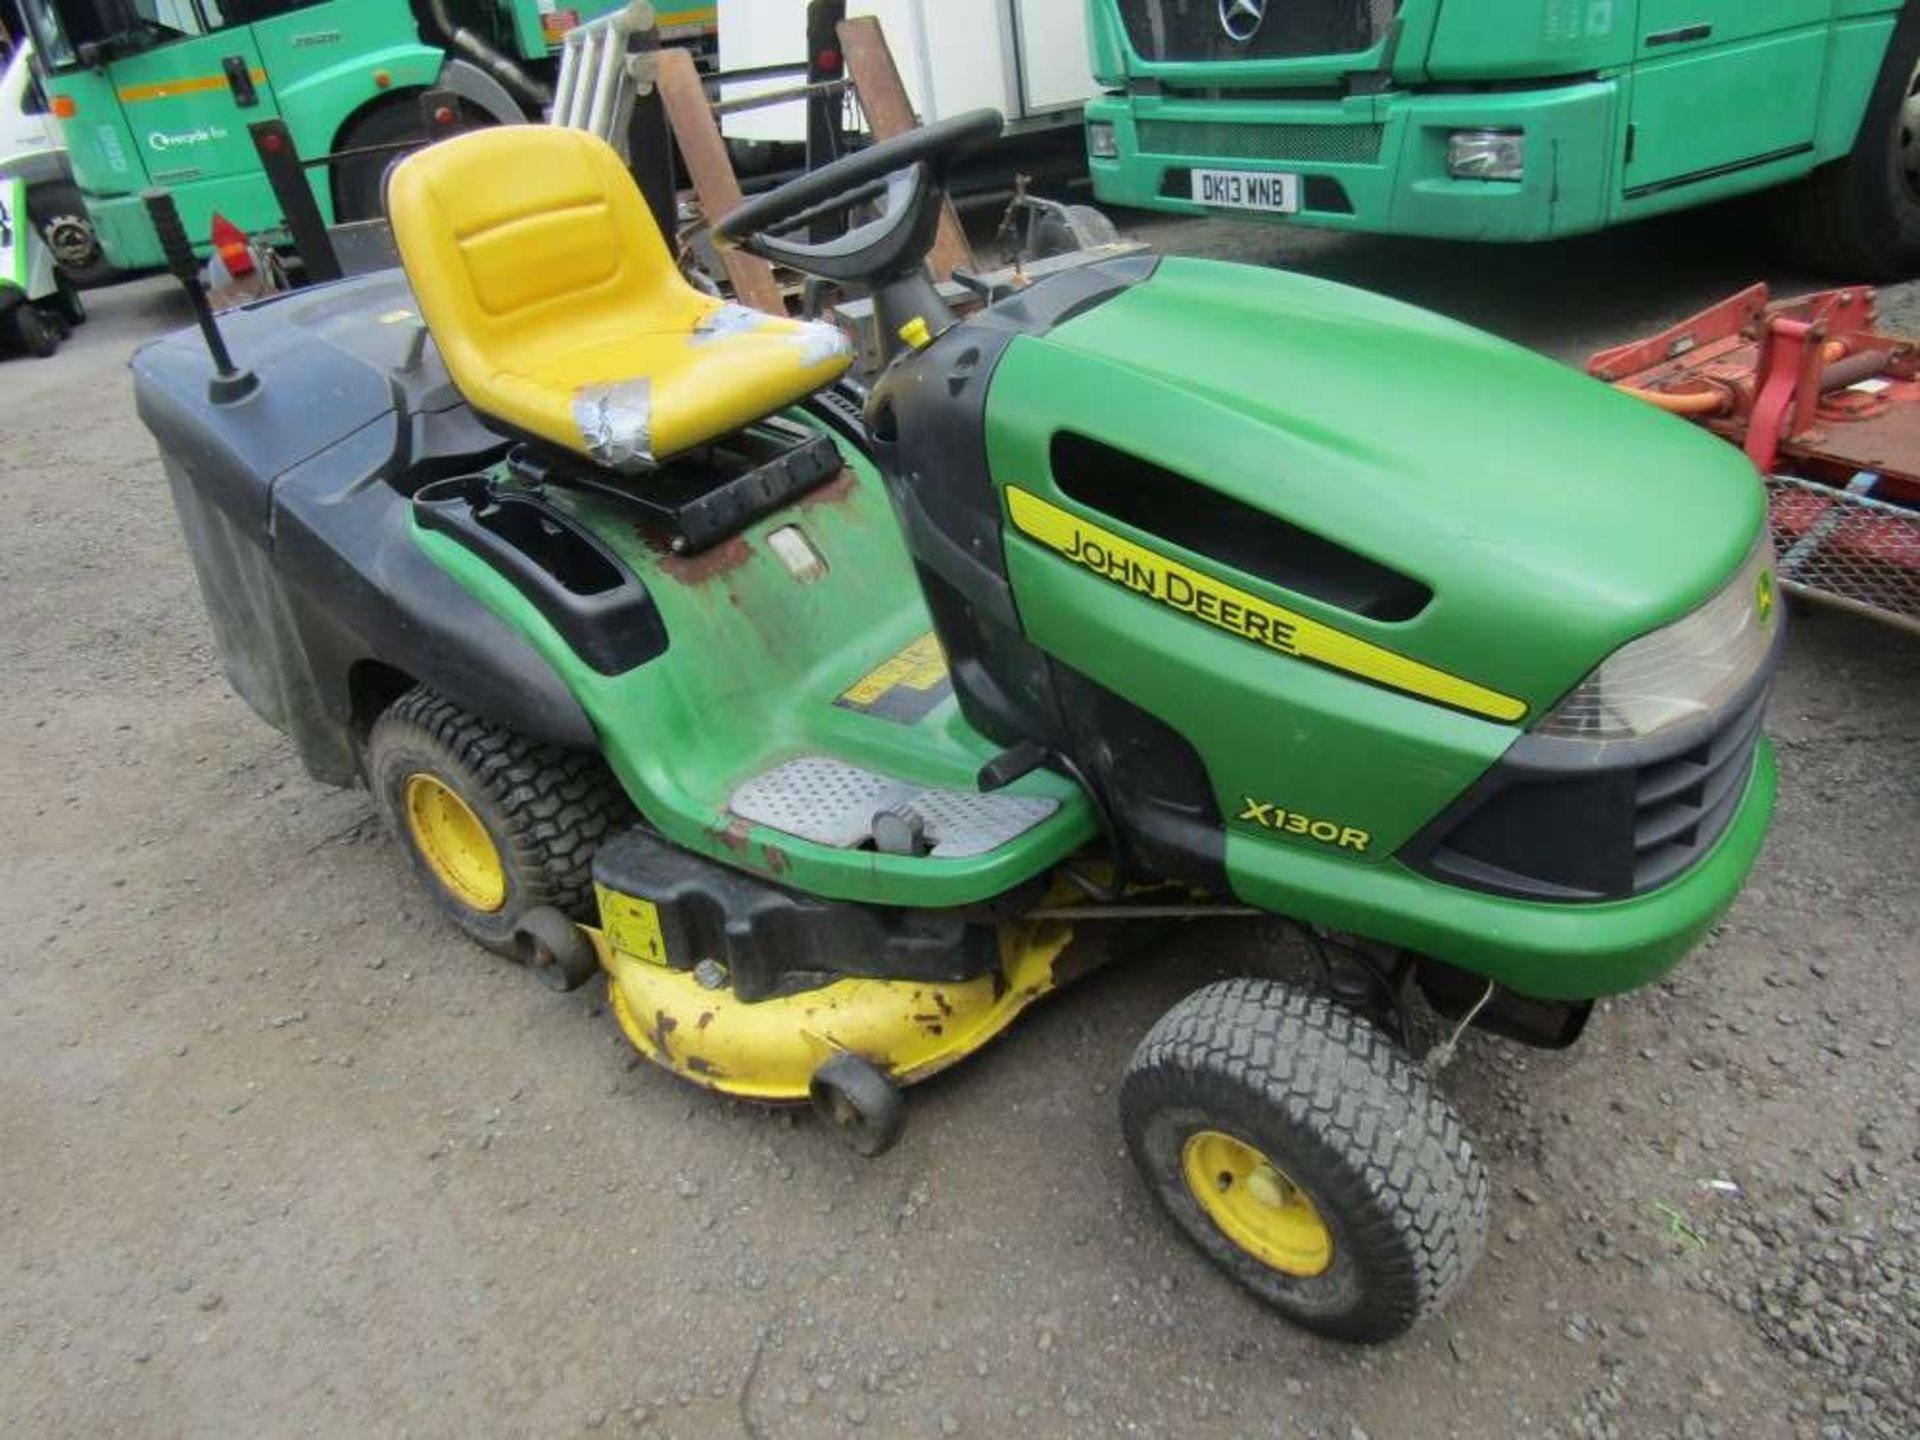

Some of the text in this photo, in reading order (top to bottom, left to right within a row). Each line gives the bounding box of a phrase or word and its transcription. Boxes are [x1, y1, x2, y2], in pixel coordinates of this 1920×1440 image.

[1202, 174, 1283, 206] DK13 WNB
[1065, 530, 1297, 650] JOHN DEERE
[1240, 796, 1370, 852] X130R
